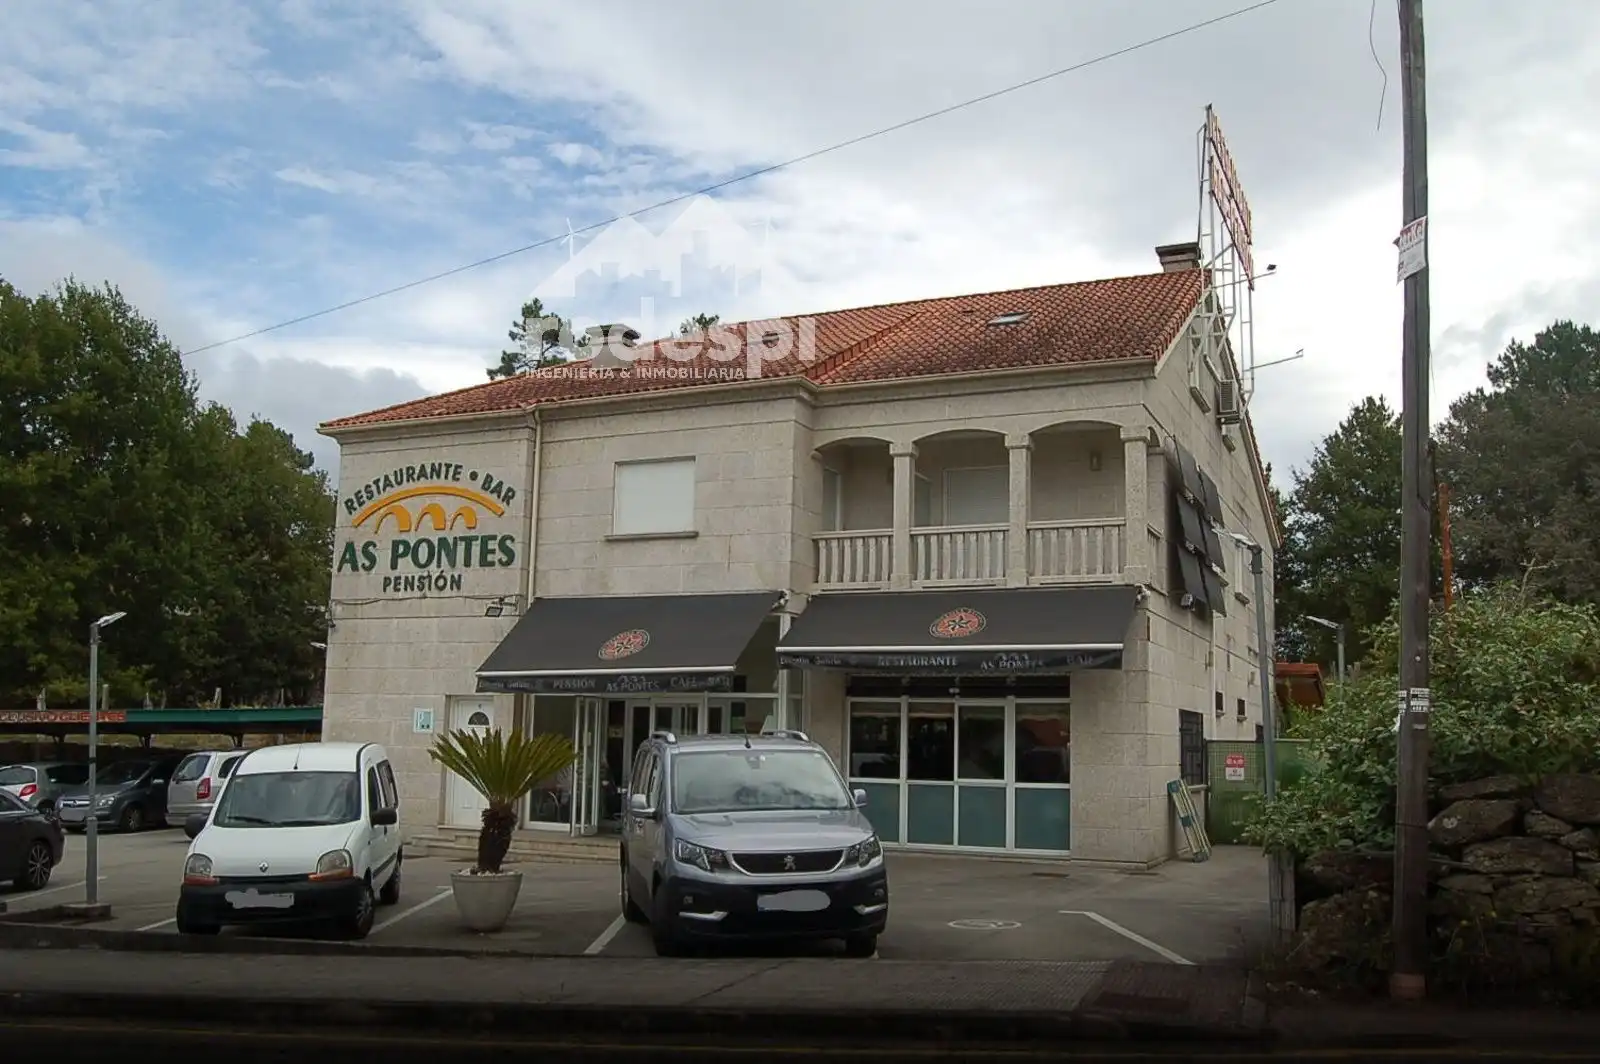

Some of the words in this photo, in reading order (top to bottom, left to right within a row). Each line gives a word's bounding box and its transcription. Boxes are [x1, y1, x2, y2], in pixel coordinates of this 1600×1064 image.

[344, 462, 463, 515] RESTAURANTE
[480, 472, 516, 507] BAR
[337, 540, 377, 572] AS
[390, 534, 516, 570] PONTES
[382, 569, 463, 593] PENSIÓN
